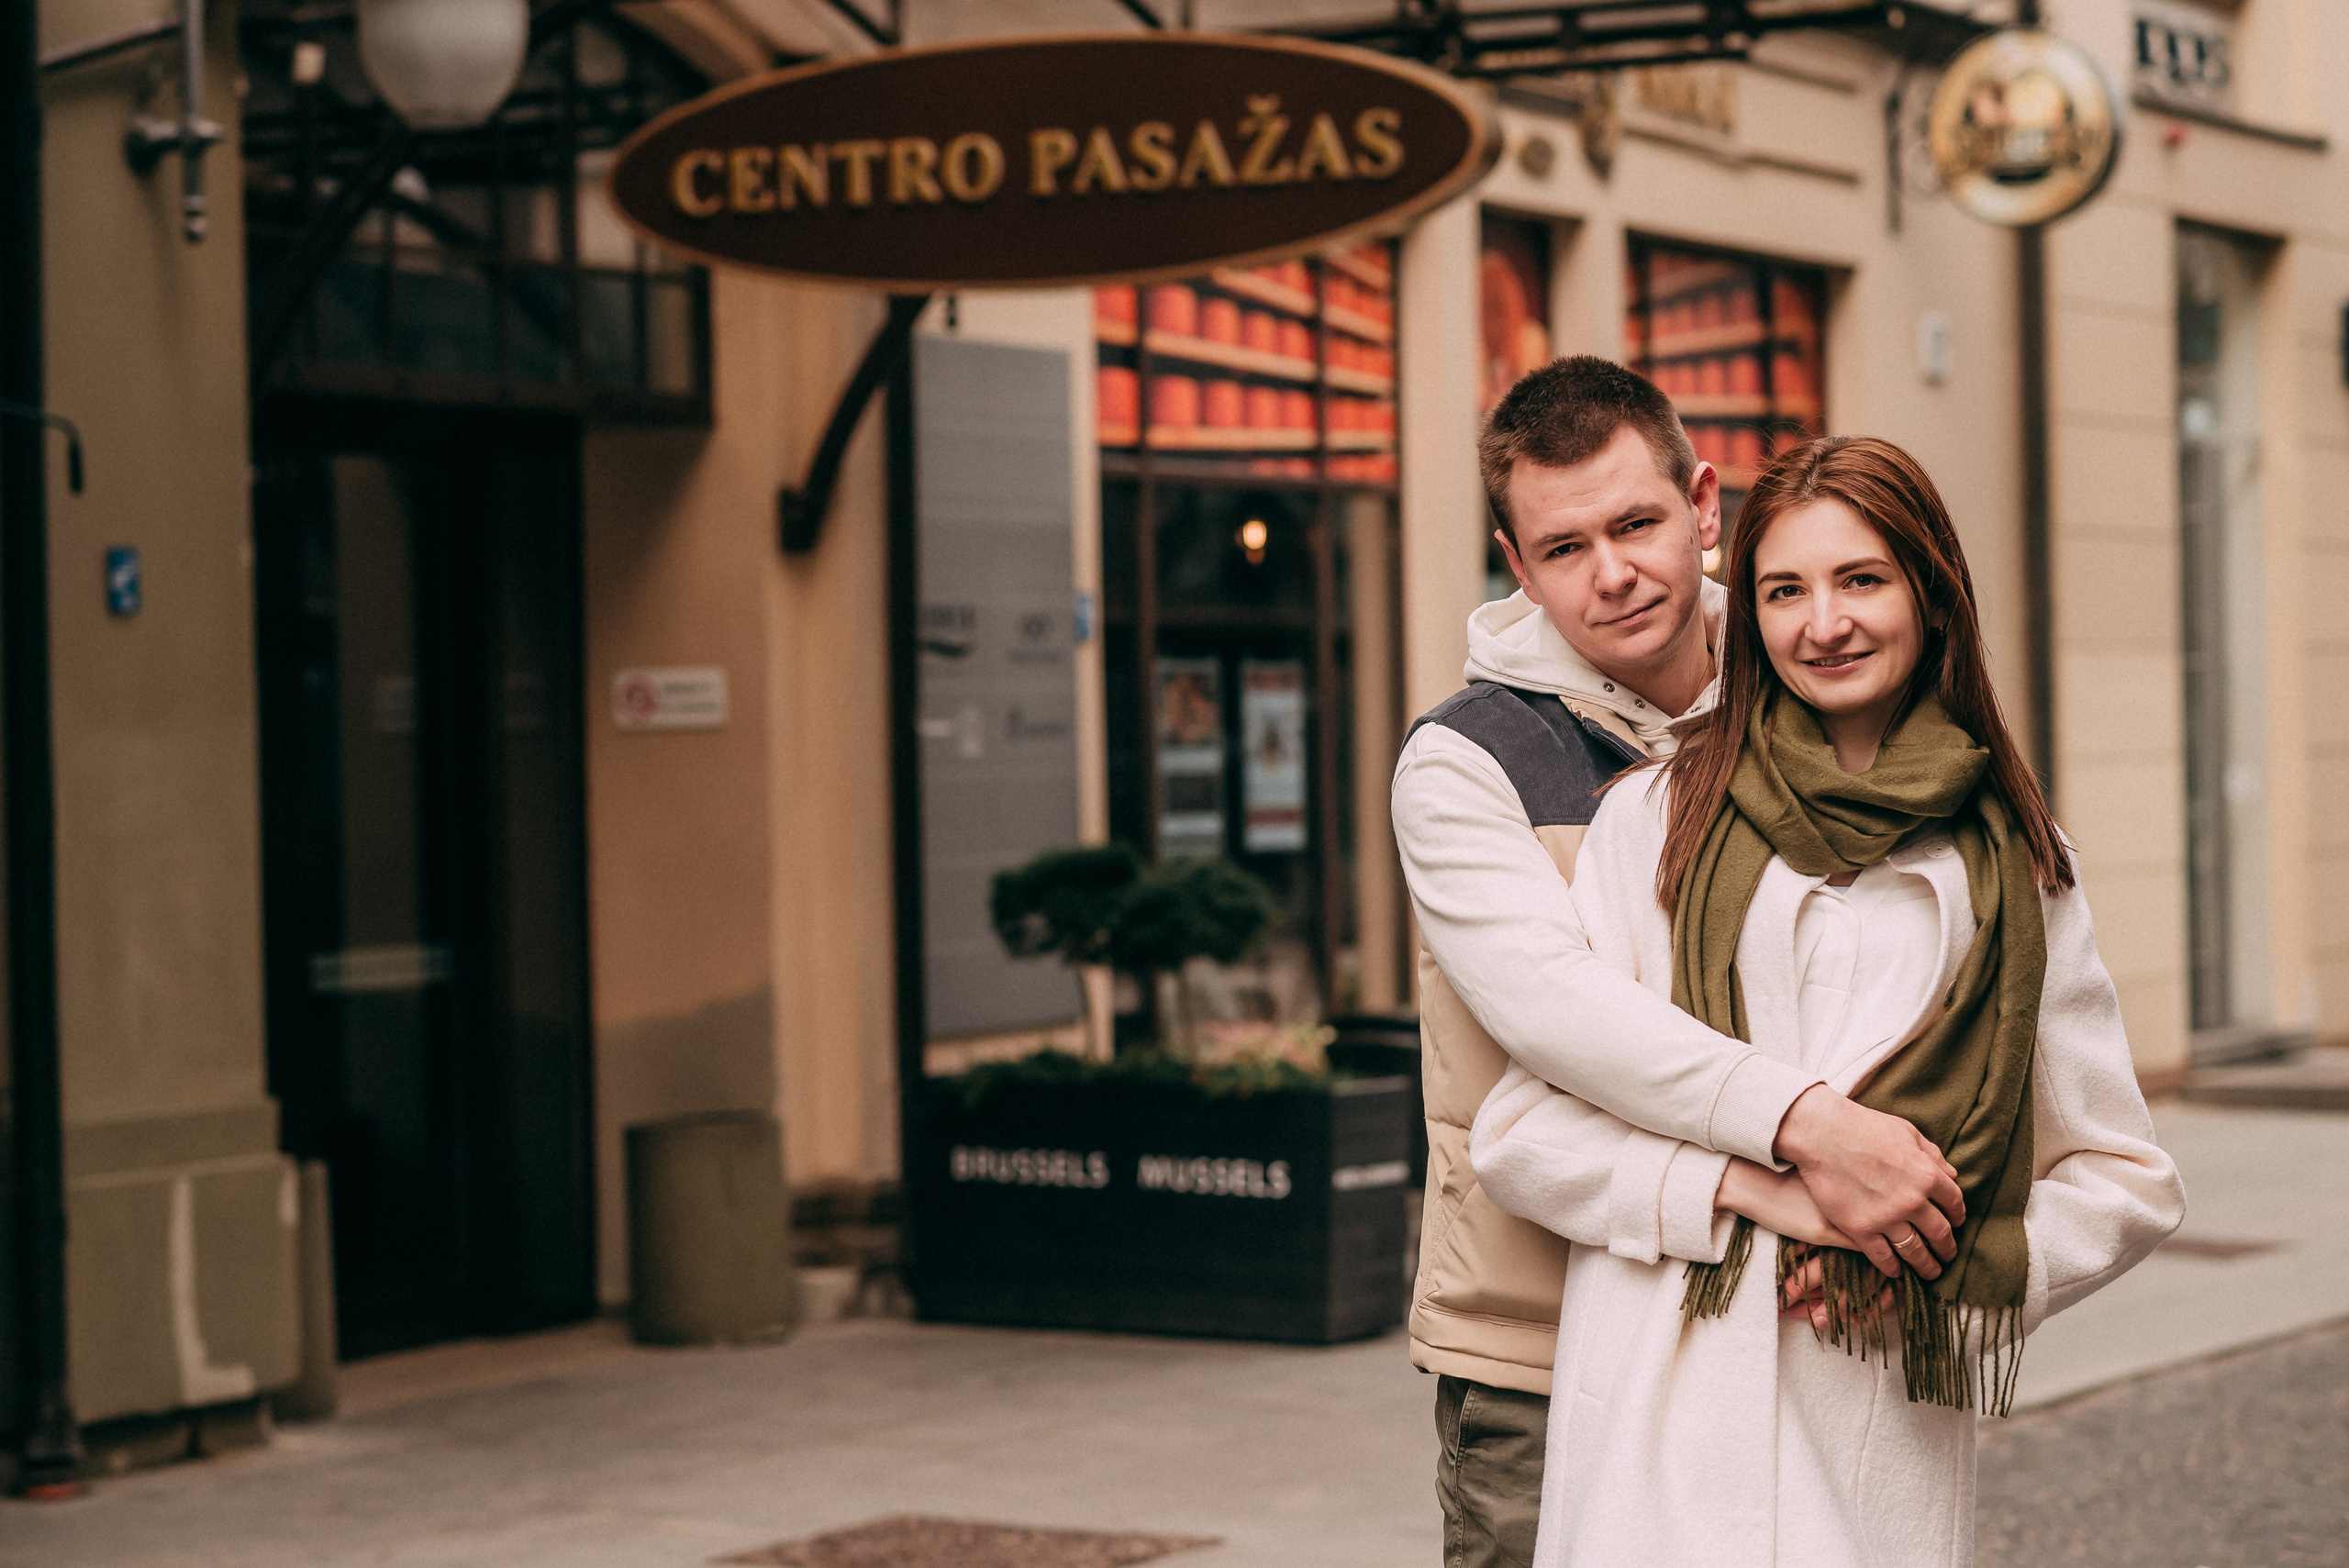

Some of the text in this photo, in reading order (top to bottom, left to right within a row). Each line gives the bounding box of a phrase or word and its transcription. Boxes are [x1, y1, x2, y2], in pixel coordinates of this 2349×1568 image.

[671, 94, 1405, 217] CENTRO PASAŽAS
[952, 1146, 1109, 1189] BRUSSELS
[1138, 1155, 1291, 1199] MUSSELS
